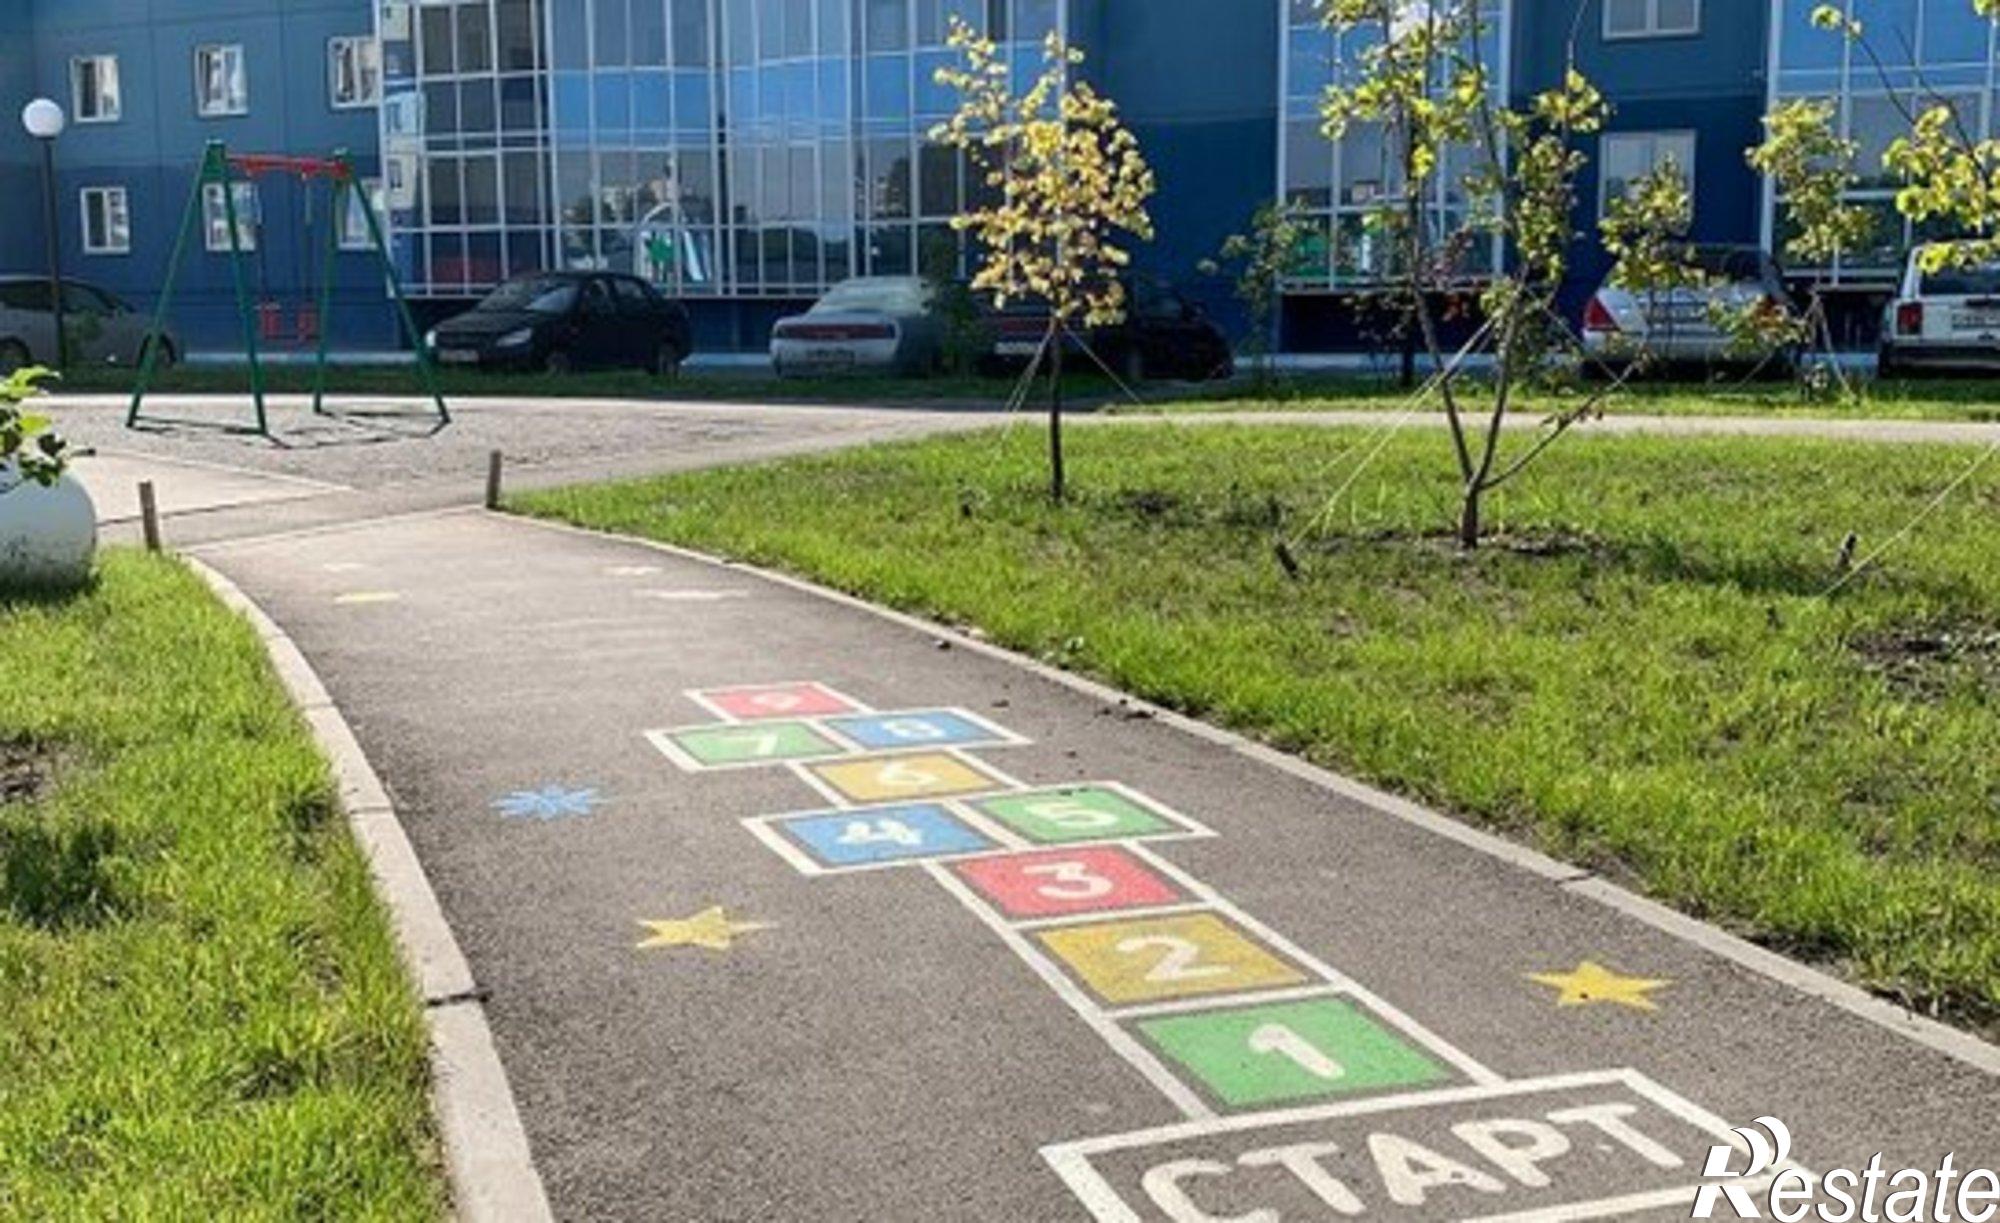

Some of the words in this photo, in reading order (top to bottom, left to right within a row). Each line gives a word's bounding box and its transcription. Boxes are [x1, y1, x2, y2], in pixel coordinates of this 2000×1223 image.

[717, 732, 780, 755] 7
[881, 716, 947, 740] 8
[875, 760, 938, 787] 6
[1022, 799, 1118, 830] 5
[837, 817, 924, 846] 4
[1022, 859, 1114, 899] 3
[1117, 934, 1232, 982] 2
[1247, 1023, 1343, 1079] 1
[1142, 1103, 1684, 1223] СТАРТ
